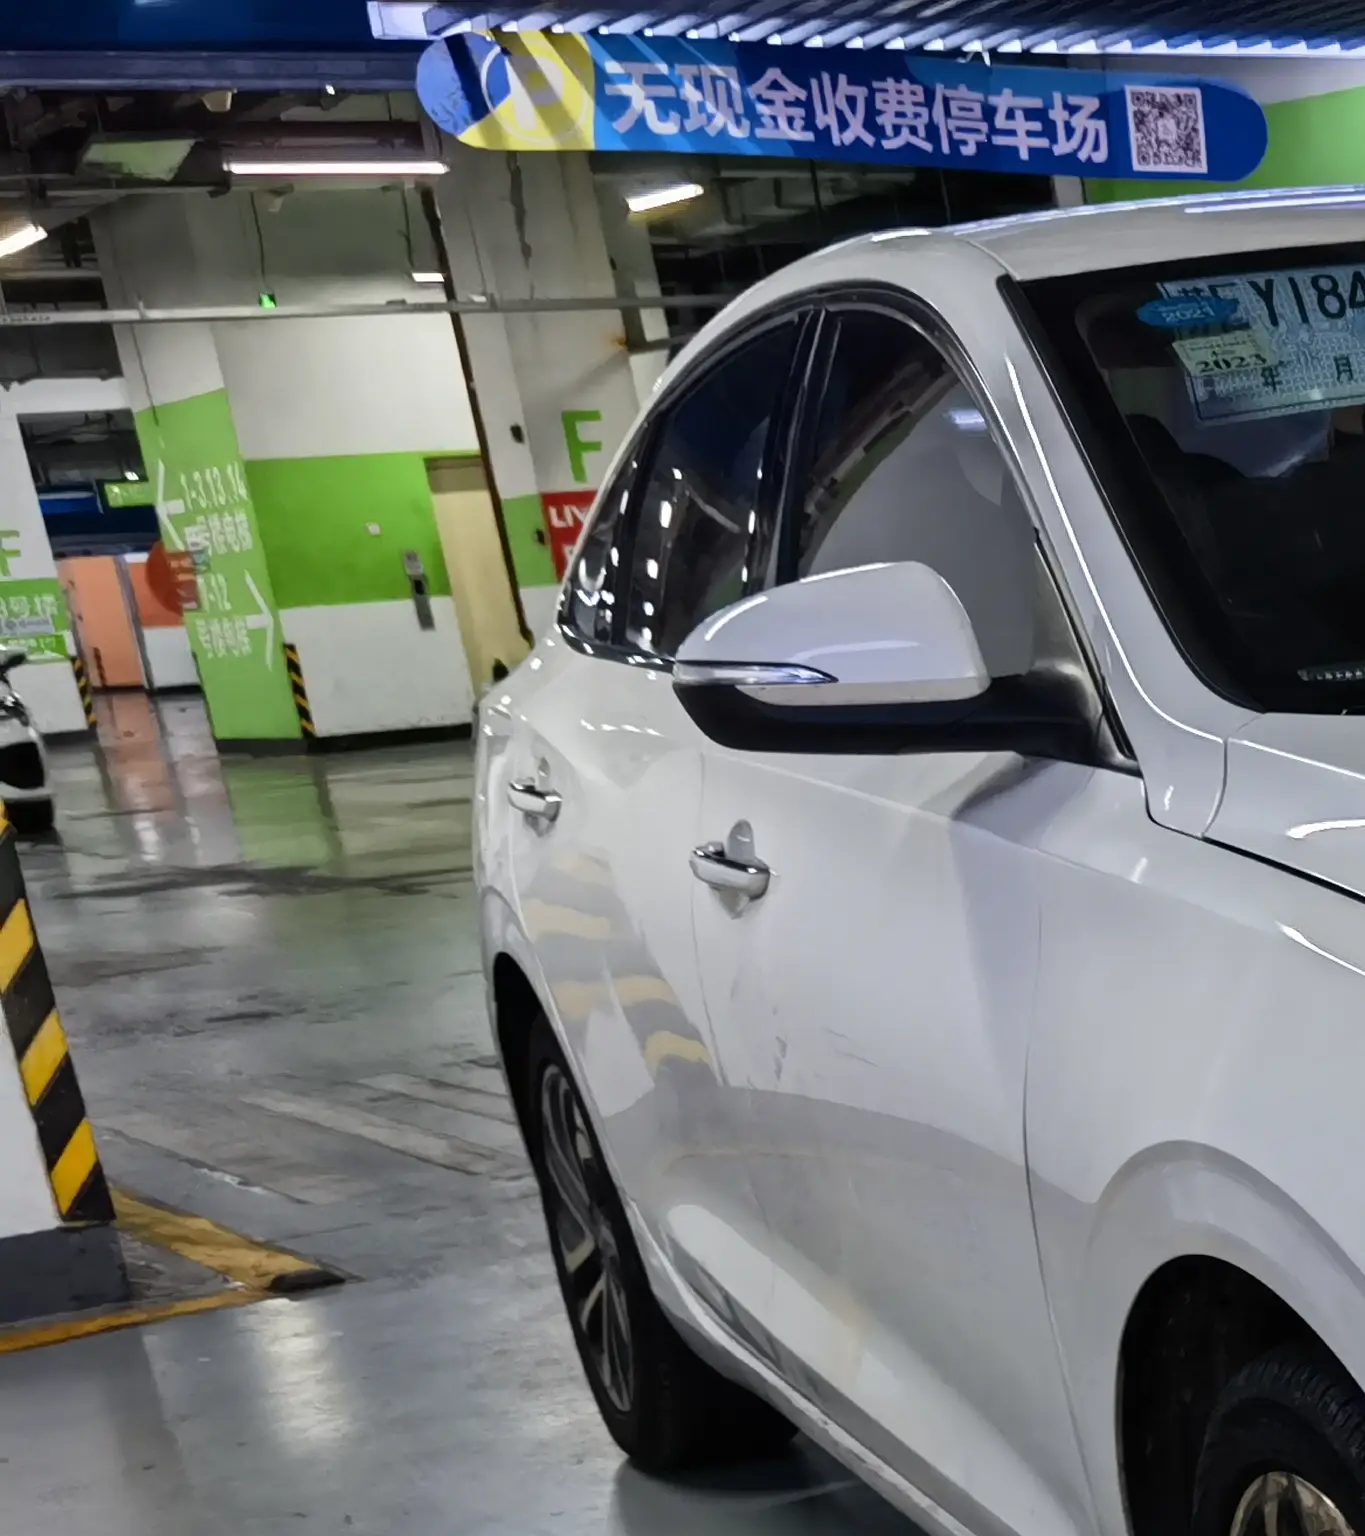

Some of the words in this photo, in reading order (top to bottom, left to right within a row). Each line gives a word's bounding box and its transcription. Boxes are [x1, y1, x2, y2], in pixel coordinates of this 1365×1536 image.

[604, 60, 1109, 163] 无现金收费停车场
[562, 411, 602, 483] F
